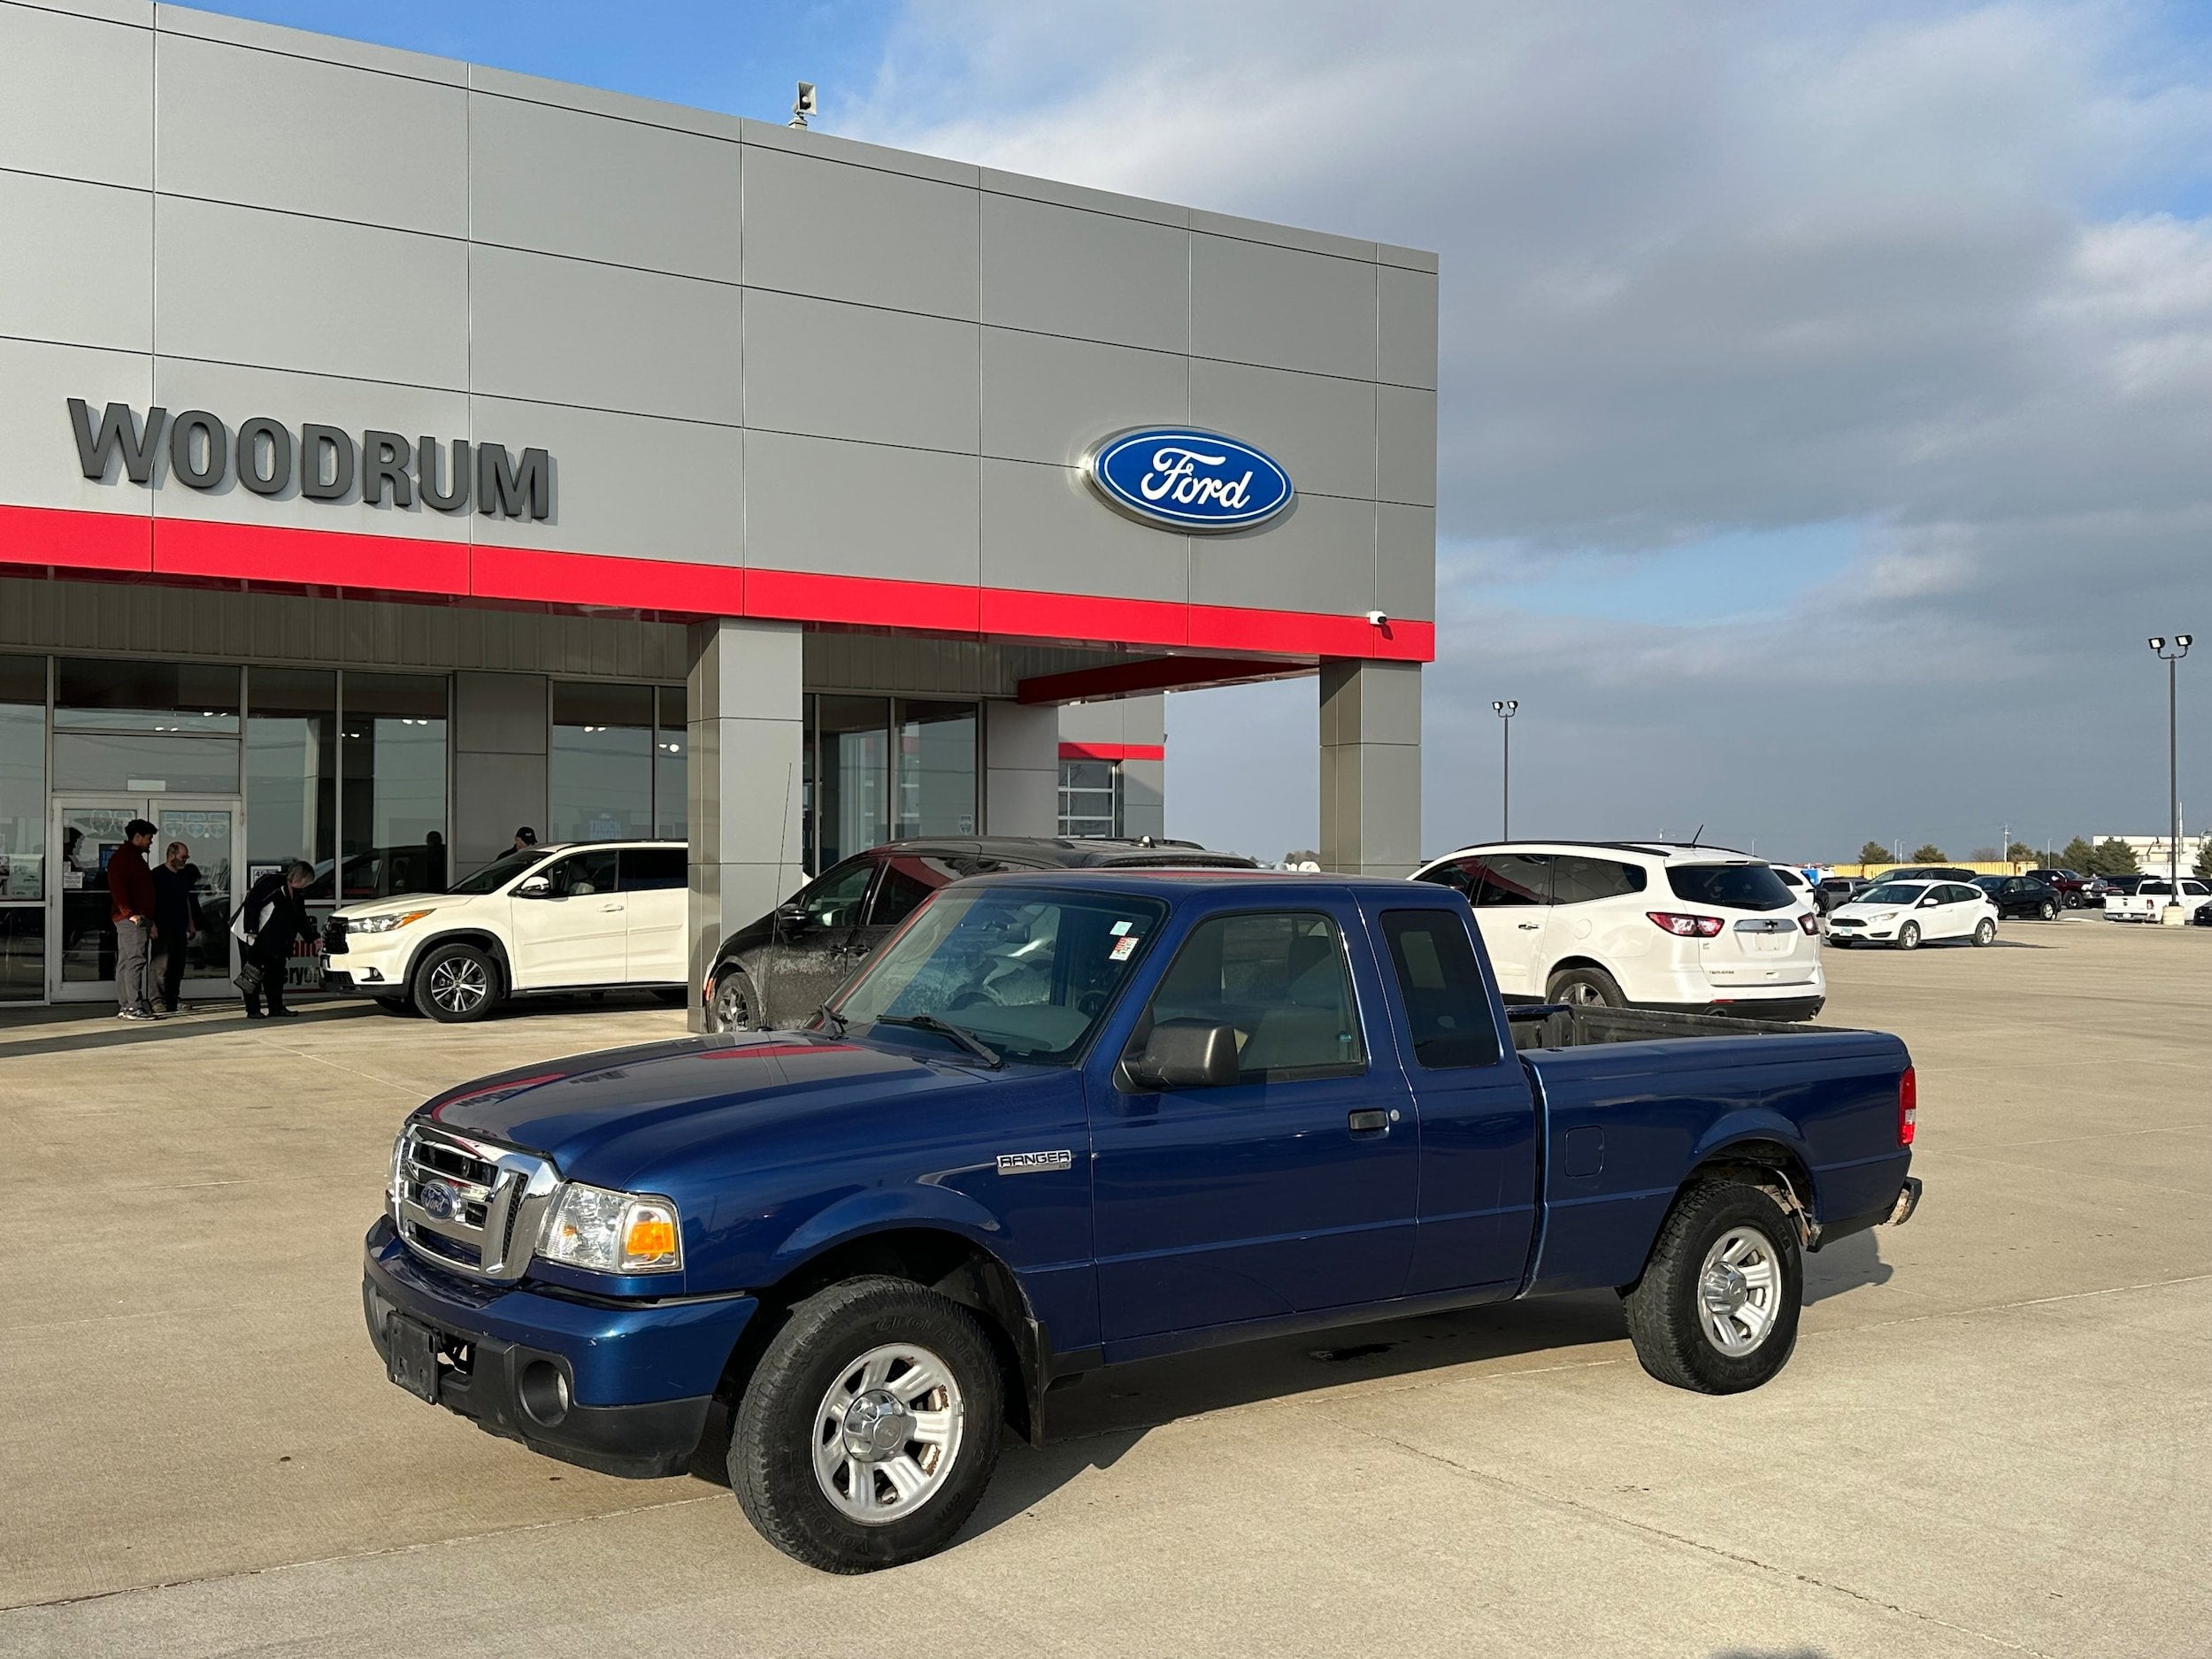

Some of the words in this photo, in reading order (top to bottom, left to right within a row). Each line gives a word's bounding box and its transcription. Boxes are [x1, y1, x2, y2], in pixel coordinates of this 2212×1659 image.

[67, 397, 549, 519] WOODRUM
[1141, 447, 1253, 509] Ford
[1000, 1152, 1070, 1167] RANGER
[425, 1187, 448, 1213] Ford
